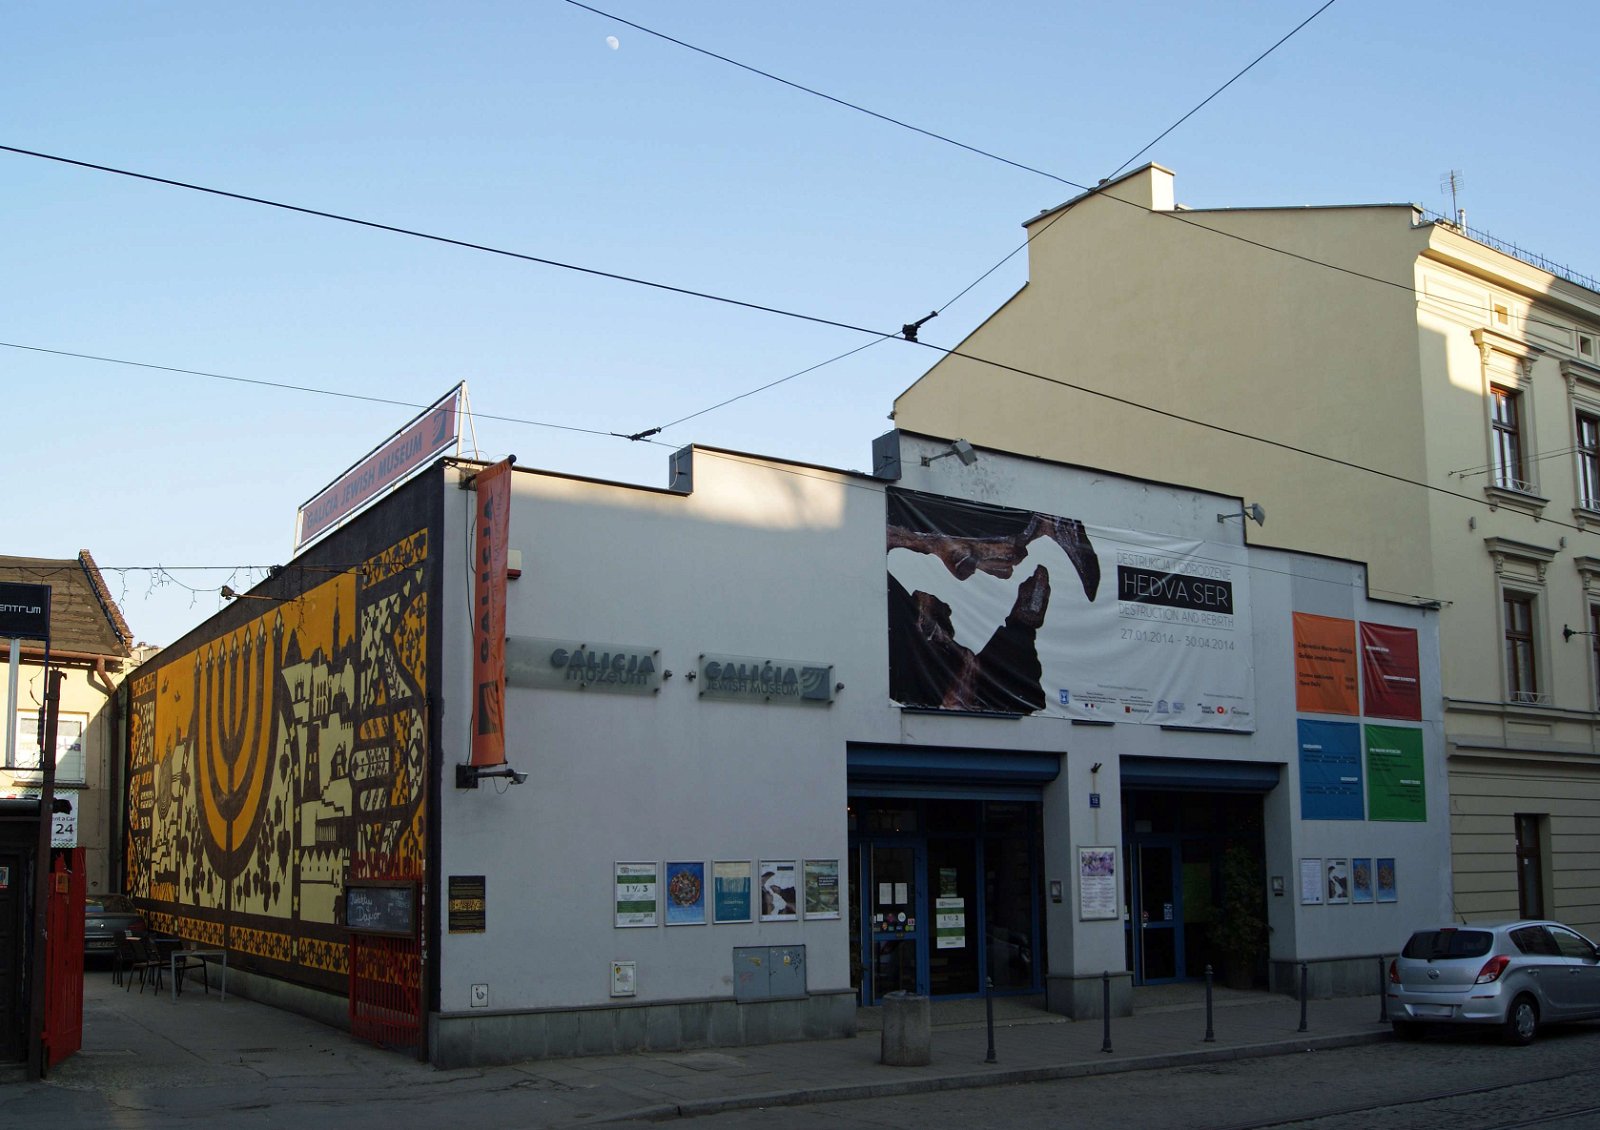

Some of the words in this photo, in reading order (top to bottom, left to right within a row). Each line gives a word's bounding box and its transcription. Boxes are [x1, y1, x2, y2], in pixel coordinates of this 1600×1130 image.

[341, 465, 375, 506] JEWISH
[378, 432, 423, 479] MUSEUM
[1124, 572, 1190, 602] HEDVA
[1192, 582, 1228, 607] SER
[1119, 602, 1179, 621] DESTRUCTION
[1182, 610, 1200, 623] AND
[1120, 628, 1174, 643] 27.01.2014
[1185, 635, 1235, 651] 30.04.2014
[565, 667, 648, 685] muzeum
[705, 661, 798, 684] GALICIA
[706, 679, 747, 693] JEWISH
[750, 681, 799, 697] MUSEUM
[55, 823, 74, 834] 24
